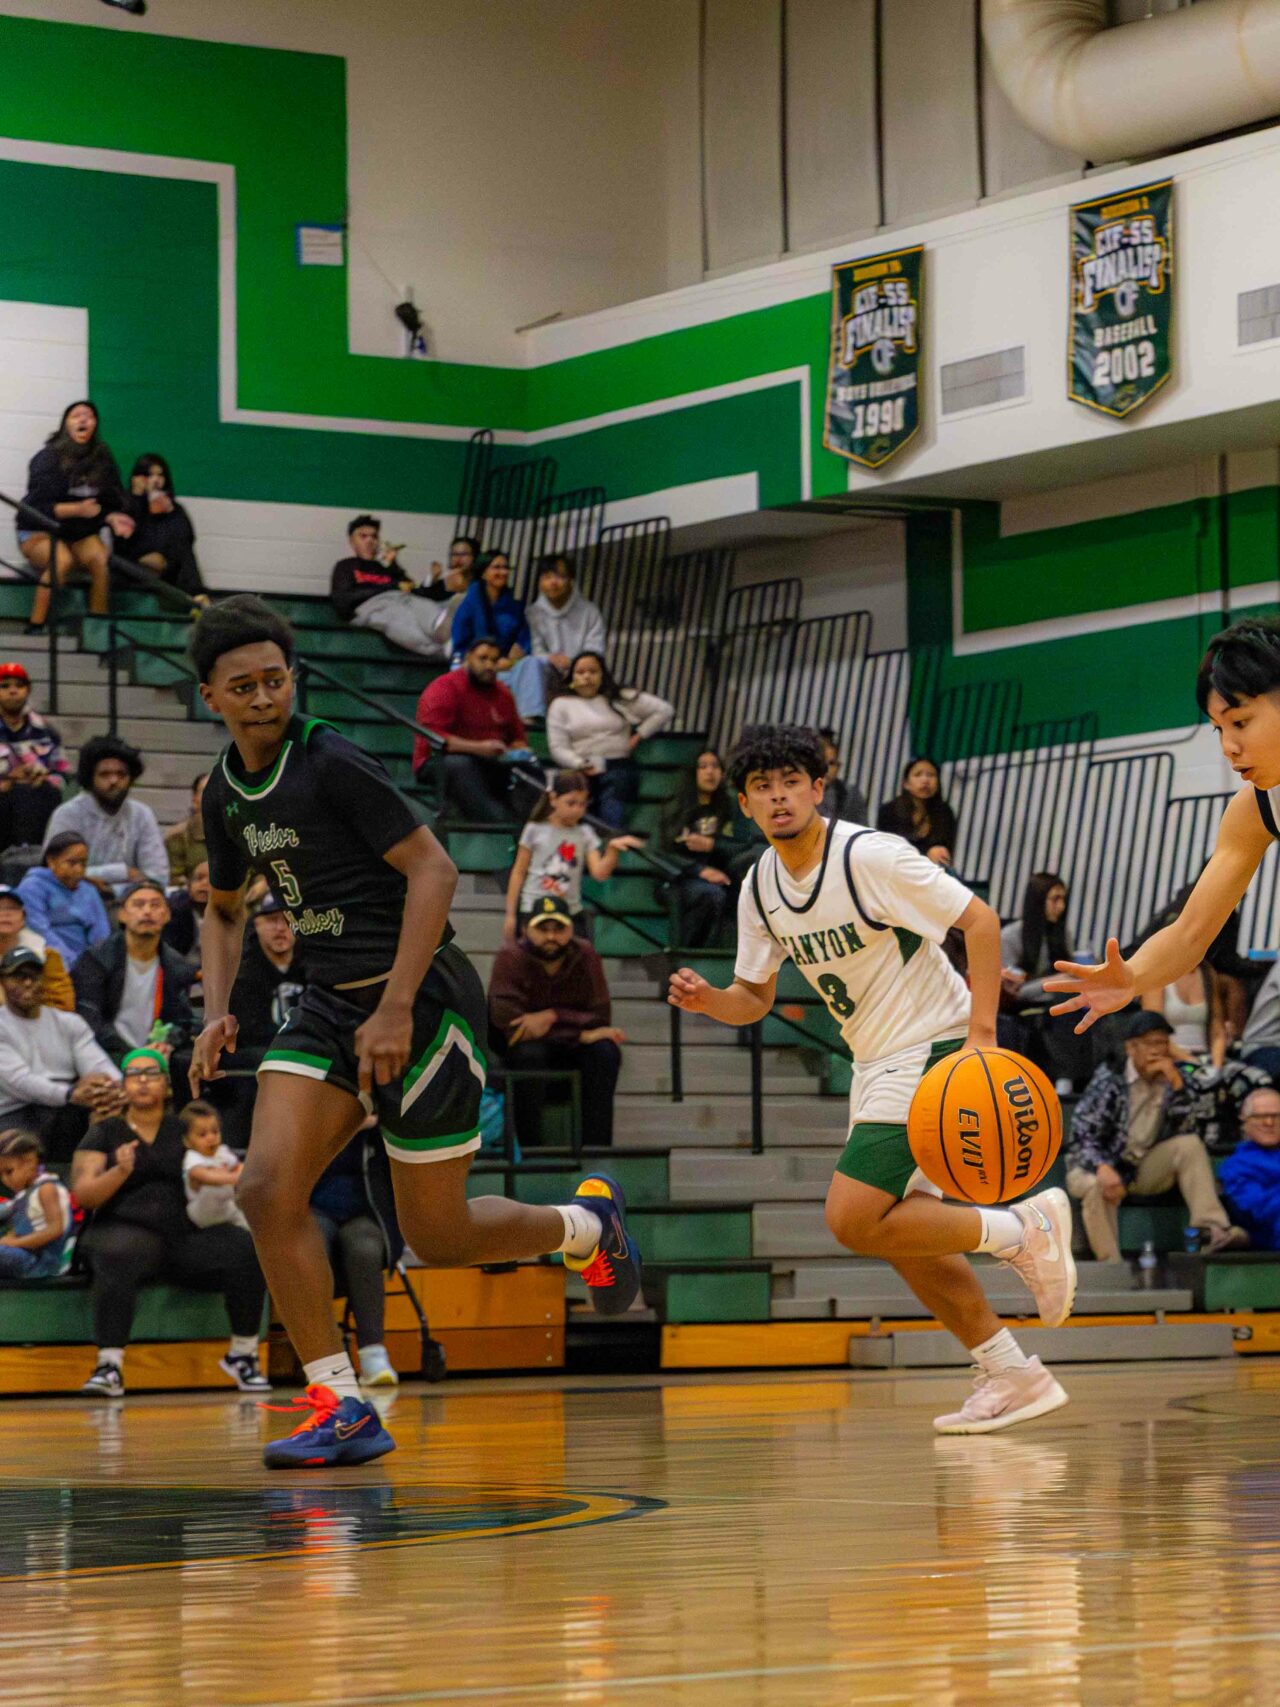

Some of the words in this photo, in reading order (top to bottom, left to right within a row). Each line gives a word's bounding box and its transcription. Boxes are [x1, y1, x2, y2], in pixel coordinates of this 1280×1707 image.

[1096, 219, 1153, 254] CIF-SS
[1083, 243, 1162, 308] FINALIST
[844, 304, 916, 364] FINALIST
[1092, 340, 1155, 387] 2002
[243, 822, 299, 857] Victor
[270, 860, 302, 907] 5
[283, 907, 344, 937] Valley
[781, 921, 866, 966] ANYON
[817, 973, 855, 1020] 3
[1002, 1075, 1039, 1181] Wilson
